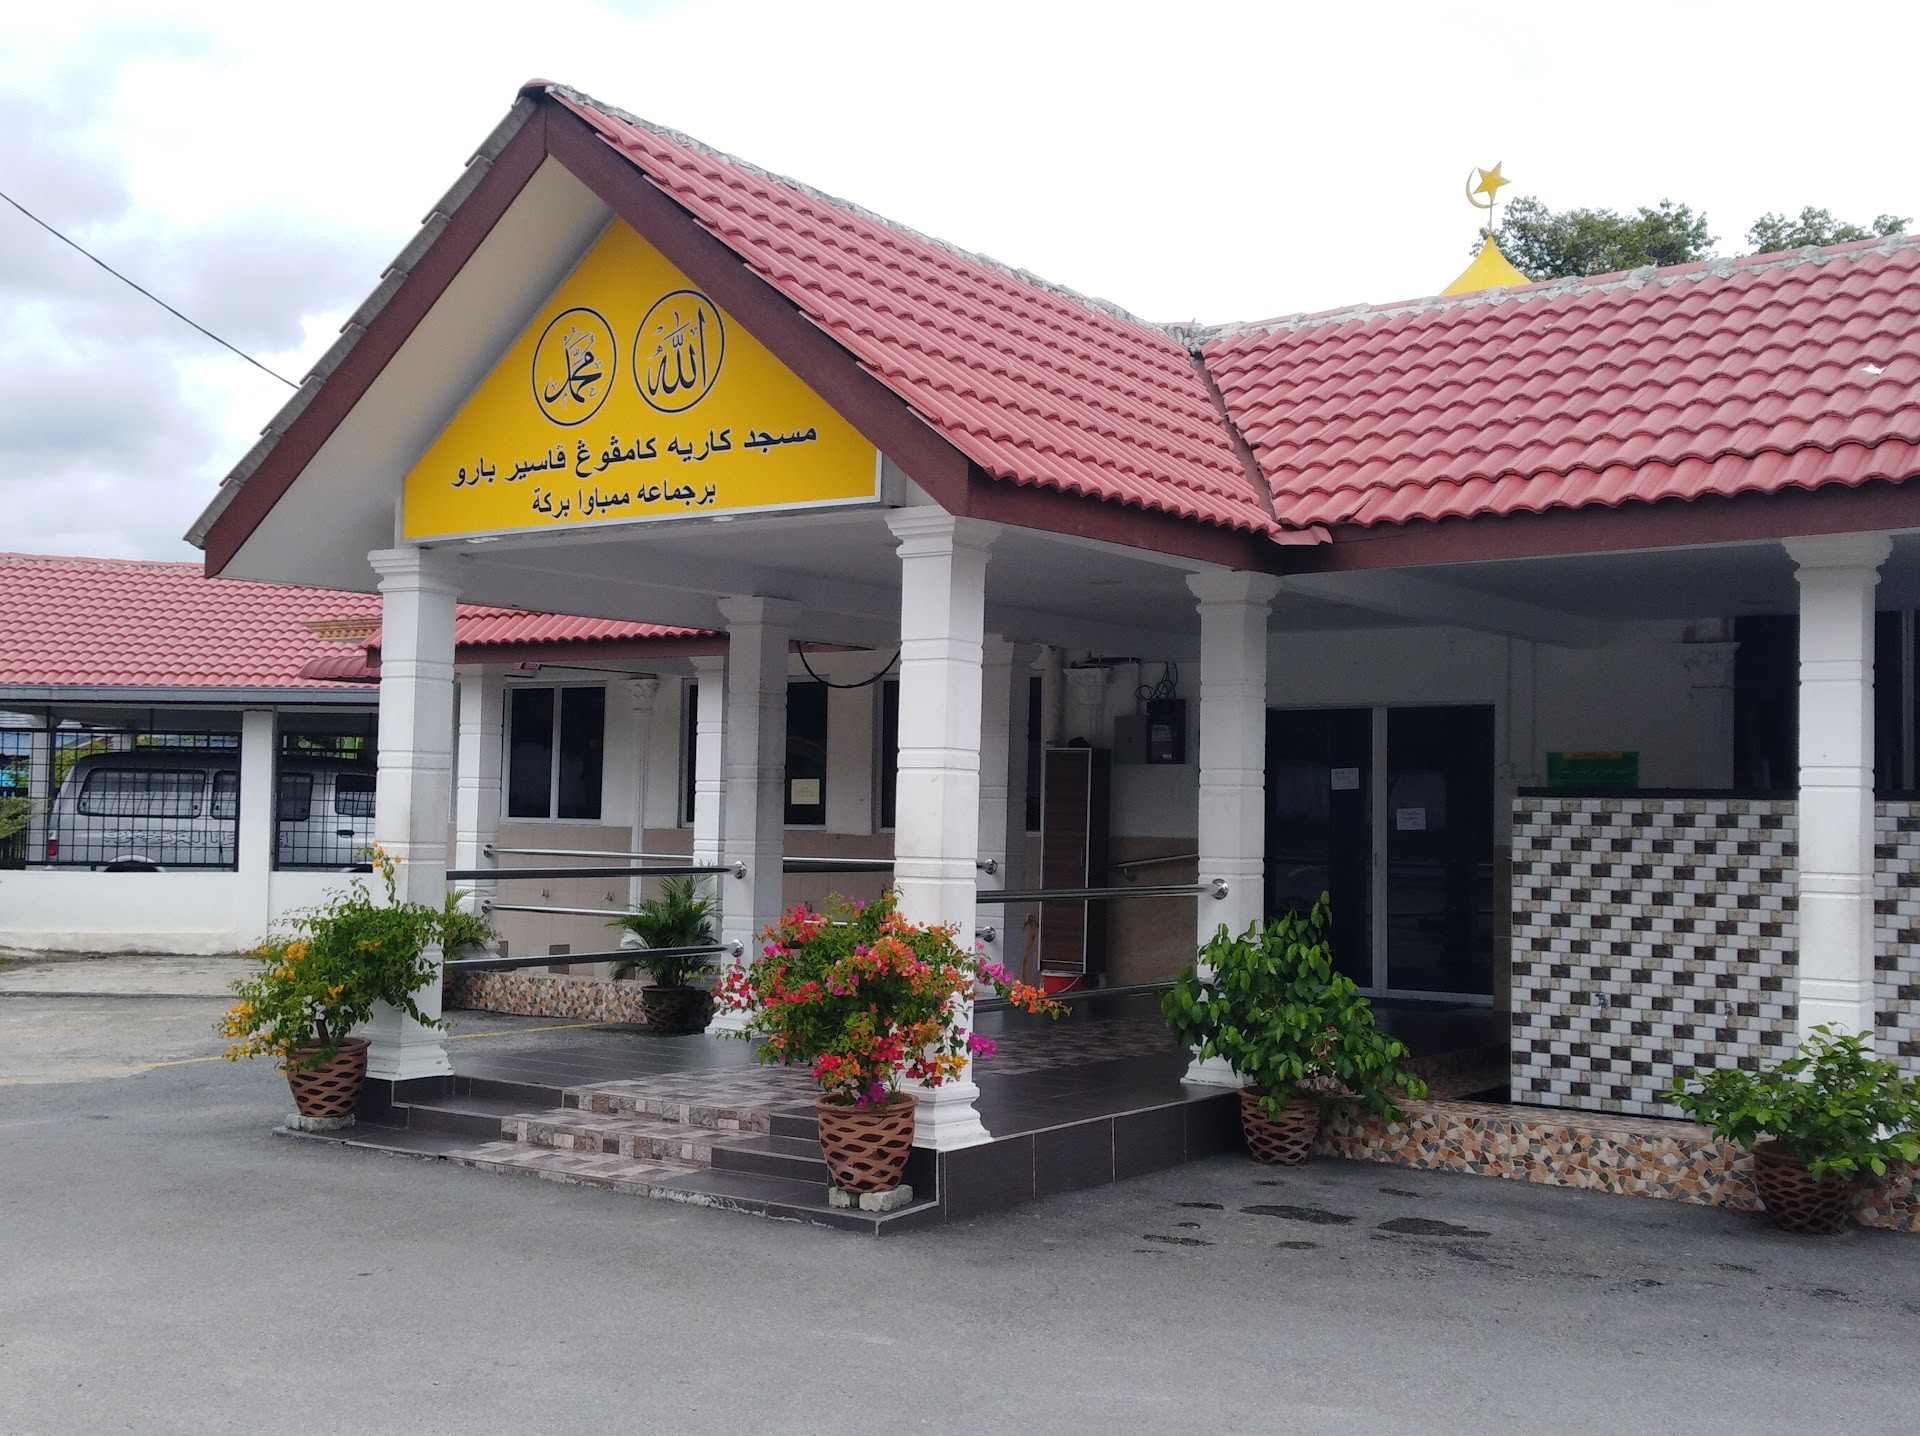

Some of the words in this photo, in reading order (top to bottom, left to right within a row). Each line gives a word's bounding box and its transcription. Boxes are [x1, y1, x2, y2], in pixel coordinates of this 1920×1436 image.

[667, 428, 732, 462] كاريه
[743, 427, 817, 454] مسجد
[450, 456, 496, 487] بارو
[532, 487, 571, 519] بركة
[578, 485, 630, 516] ممباوا
[636, 479, 717, 506] برجماعه
